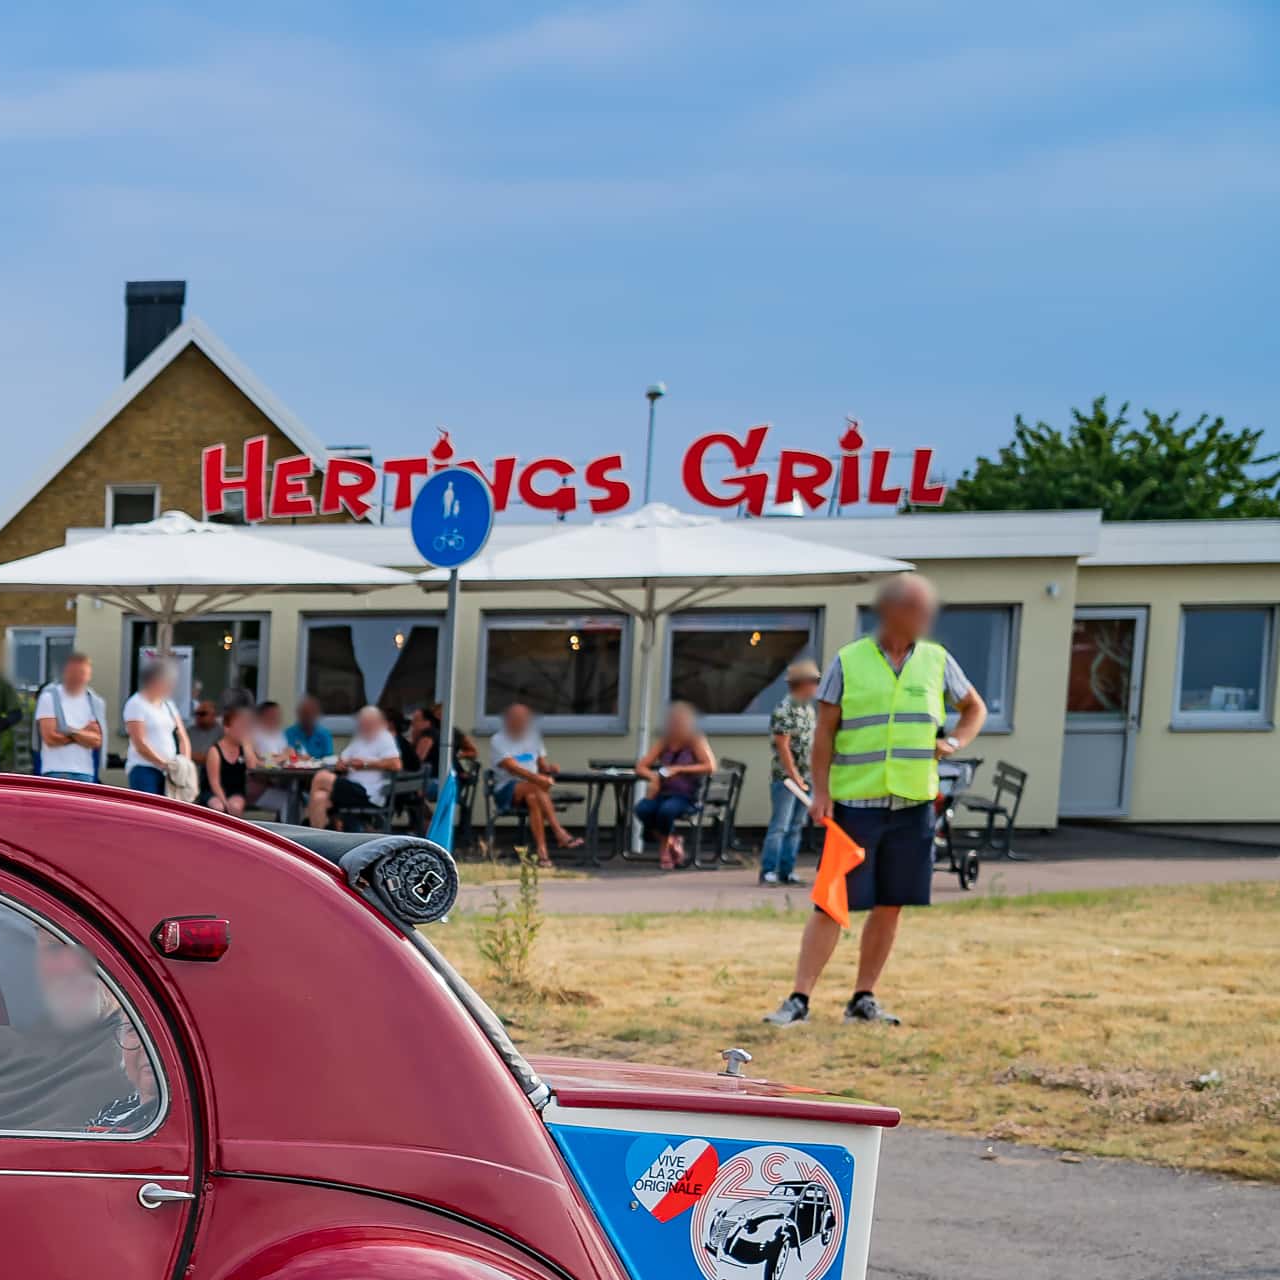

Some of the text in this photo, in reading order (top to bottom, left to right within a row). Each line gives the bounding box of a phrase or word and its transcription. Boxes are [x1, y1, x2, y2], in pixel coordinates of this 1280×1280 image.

[682, 417, 946, 518] GRILL
[658, 1154, 686, 1168] VIVE
[649, 1167, 694, 1181] LA 2CV
[634, 1178, 704, 1195] ORIGINALE
